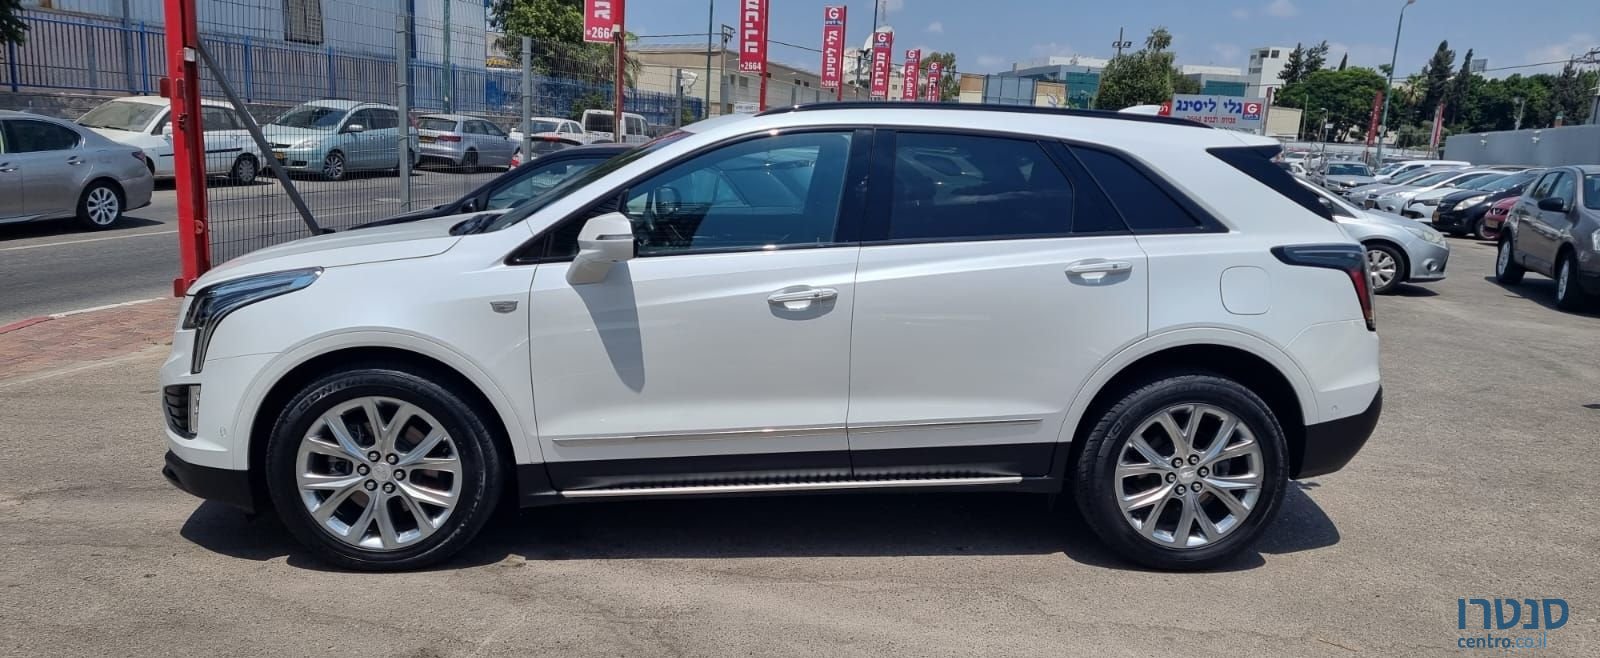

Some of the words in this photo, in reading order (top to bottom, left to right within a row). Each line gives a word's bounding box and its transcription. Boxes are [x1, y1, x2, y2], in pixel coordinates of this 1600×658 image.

[829, 8, 839, 19] G
[827, 30, 838, 45] גלי
[878, 33, 886, 42] G
[826, 47, 837, 76] ליסינג
[1176, 98, 1217, 112] ליסינג
[1223, 98, 1243, 114] גלי
[1247, 103, 1258, 114] G
